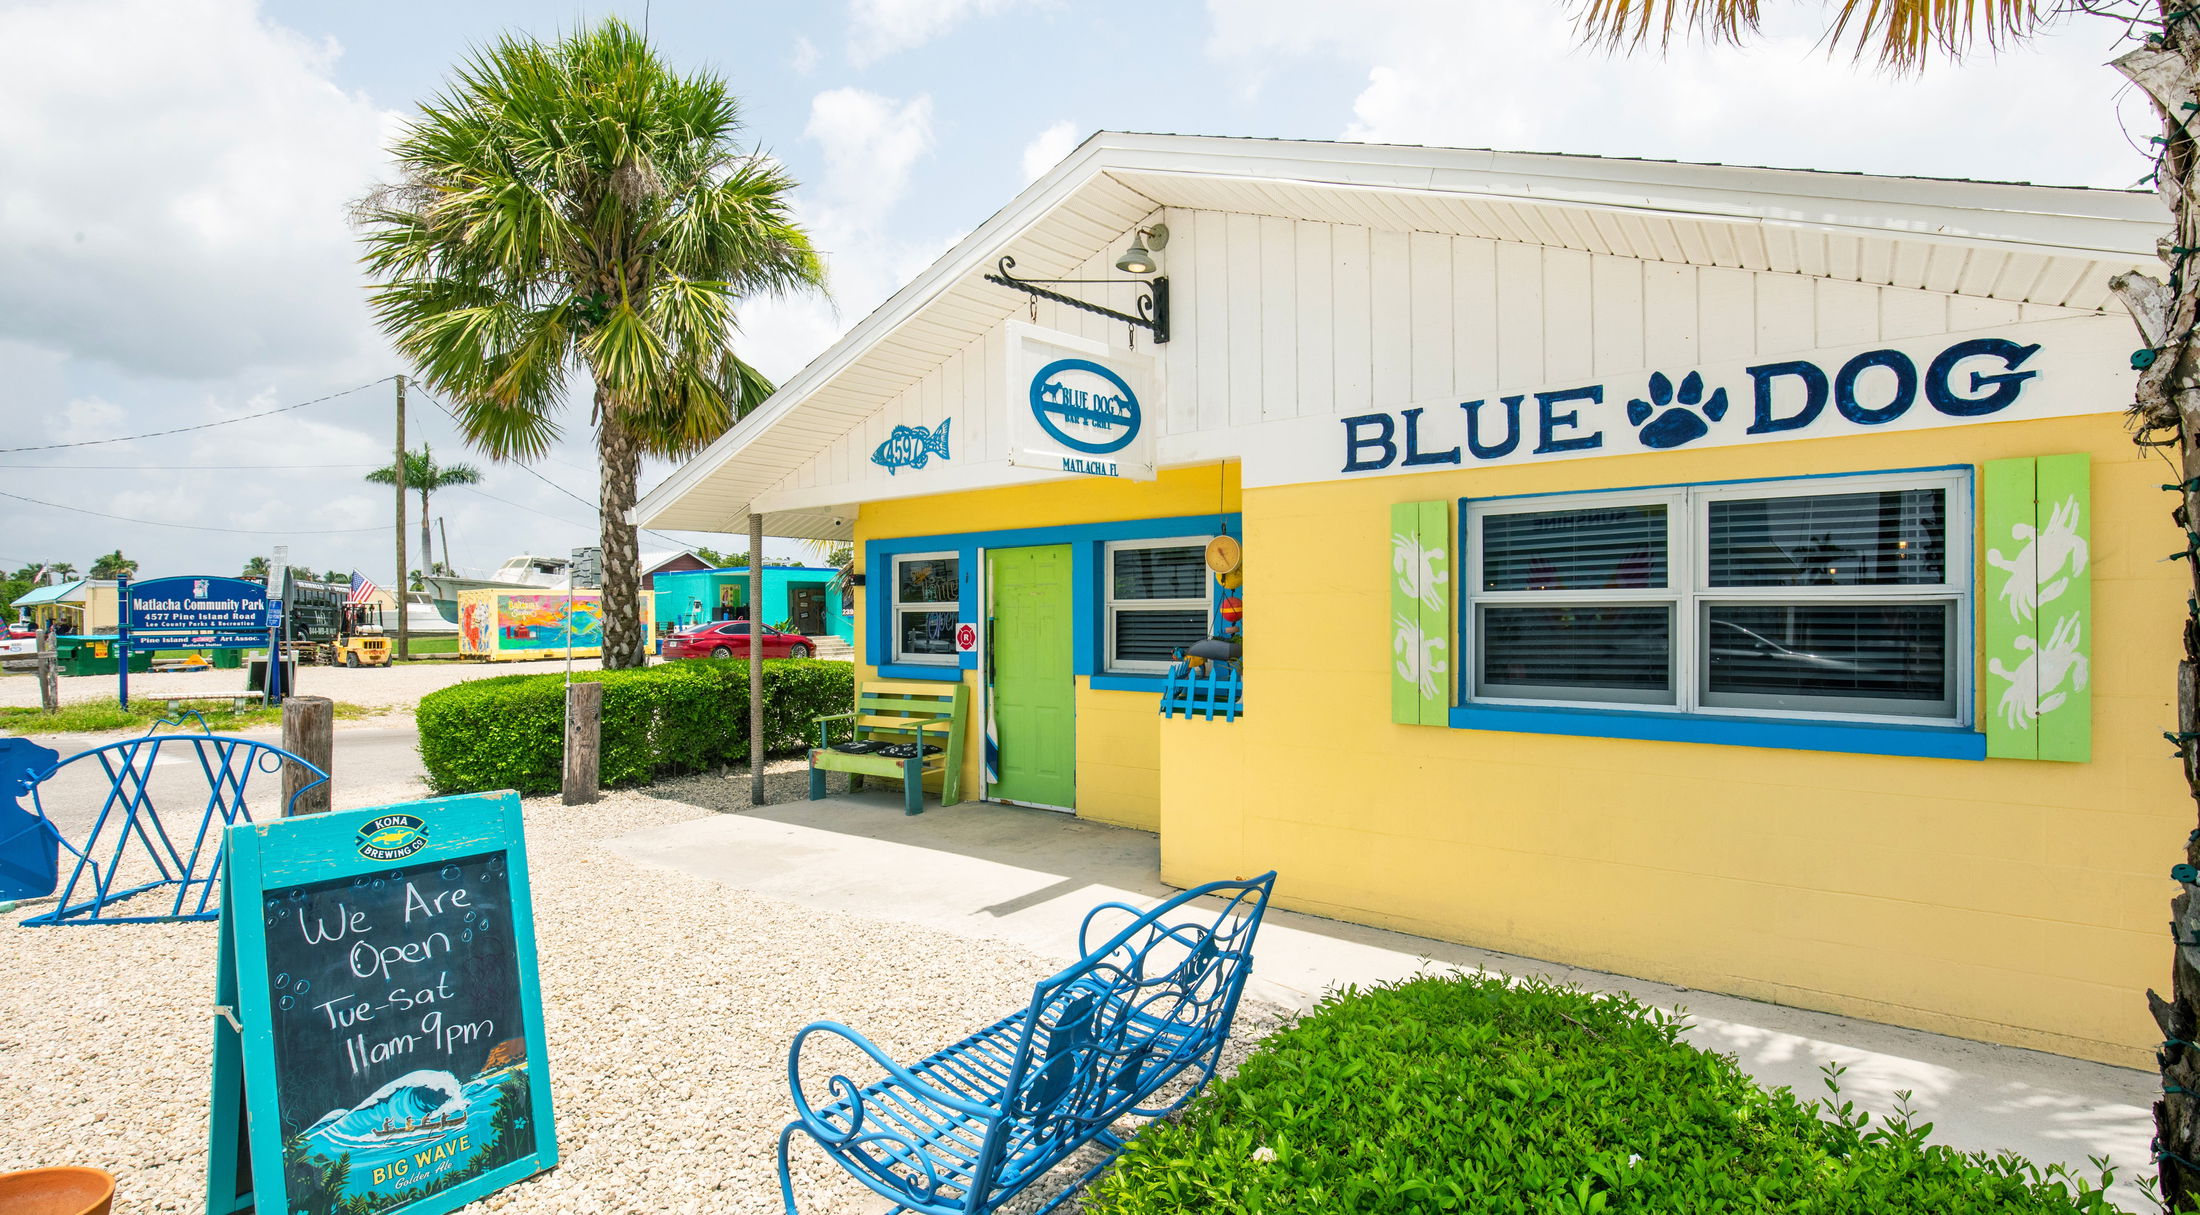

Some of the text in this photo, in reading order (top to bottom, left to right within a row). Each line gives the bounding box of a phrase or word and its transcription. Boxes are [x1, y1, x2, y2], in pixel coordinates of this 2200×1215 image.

[1062, 387, 1115, 415] BLUE DOG
[1341, 338, 2044, 474] BLUE DOG
[1064, 414, 1112, 430] BAR & GRILL
[884, 436, 922, 464] 4597
[1062, 457, 1119, 477] MATLACHA FL
[133, 598, 265, 613] Matlacha Community Park
[375, 816, 408, 829] KONA
[363, 846, 412, 859] BREWING
[299, 882, 472, 945] We Are
[350, 932, 451, 981] Open
[313, 971, 455, 1030] Tue-Sat
[347, 1011, 494, 1074] 11am-9pm
[372, 1134, 471, 1186] BIG WAVE
[394, 1159, 453, 1189] Golden Ale
